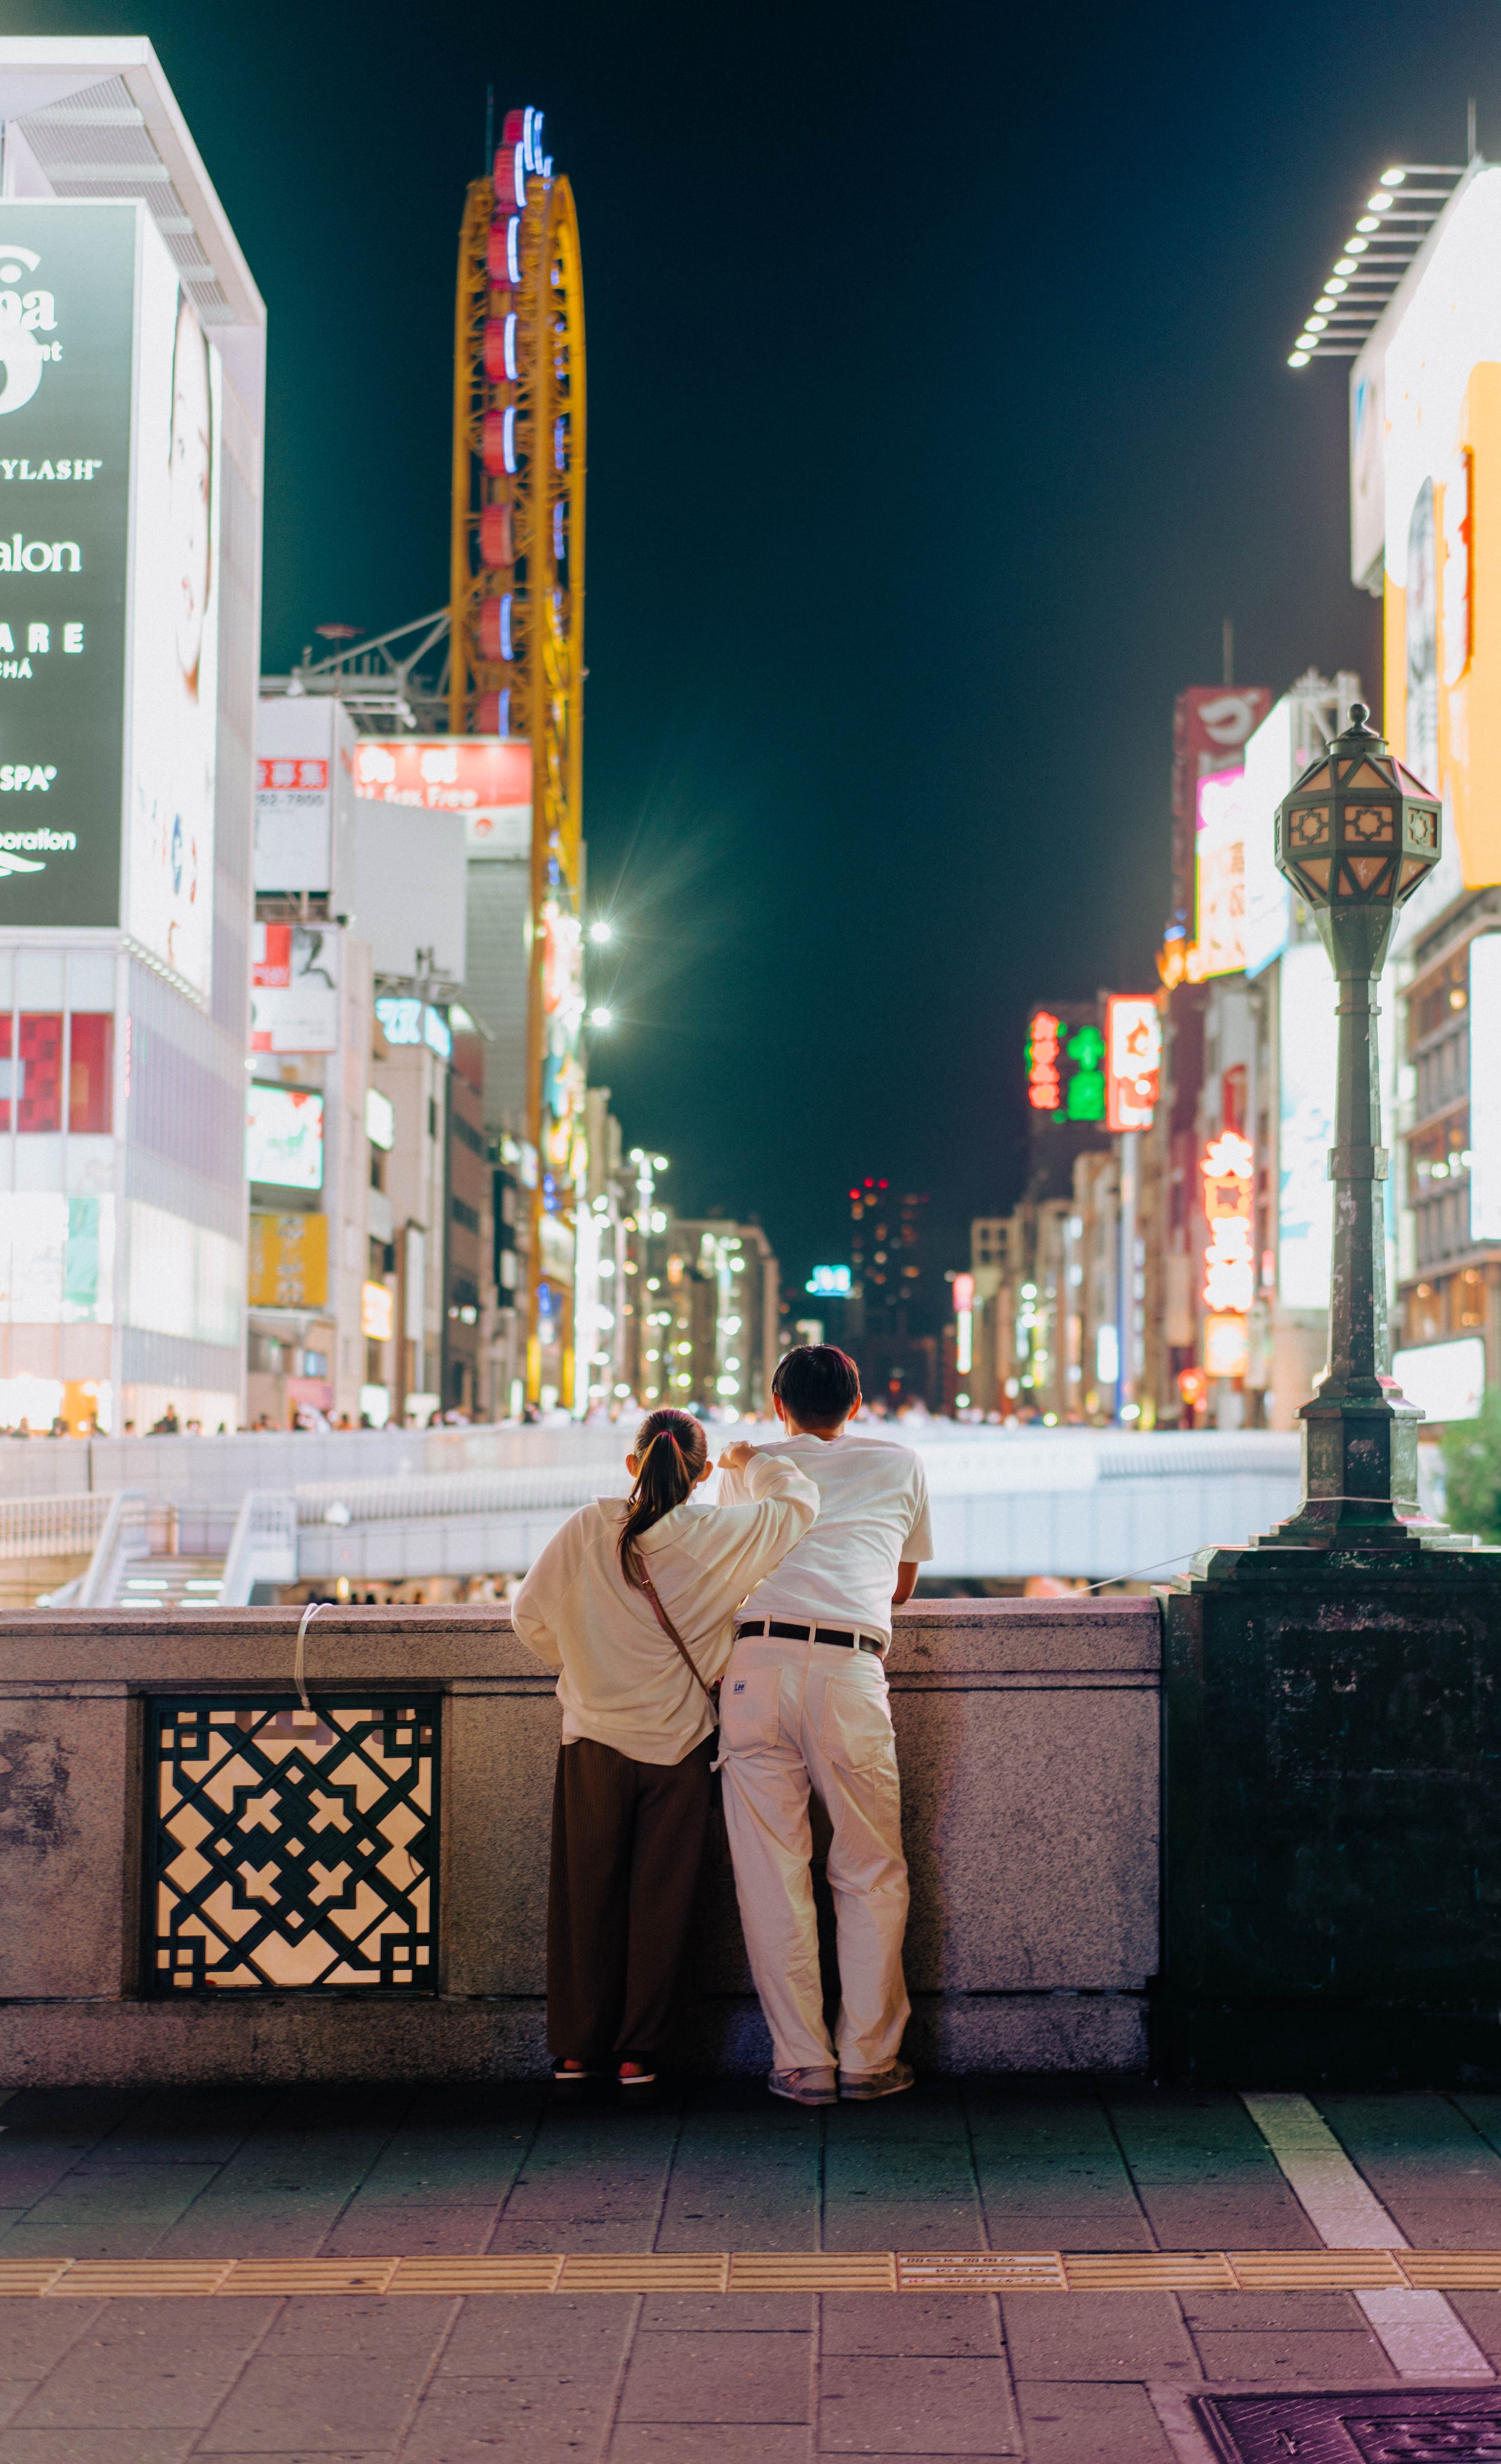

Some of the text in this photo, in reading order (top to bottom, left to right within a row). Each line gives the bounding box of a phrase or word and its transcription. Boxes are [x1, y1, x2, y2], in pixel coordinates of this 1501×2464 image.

[0, 459, 94, 481] YLASH
[0, 657, 33, 679] HÁ
[0, 827, 77, 851] oration
[734, 1683, 745, 1691] Lee
